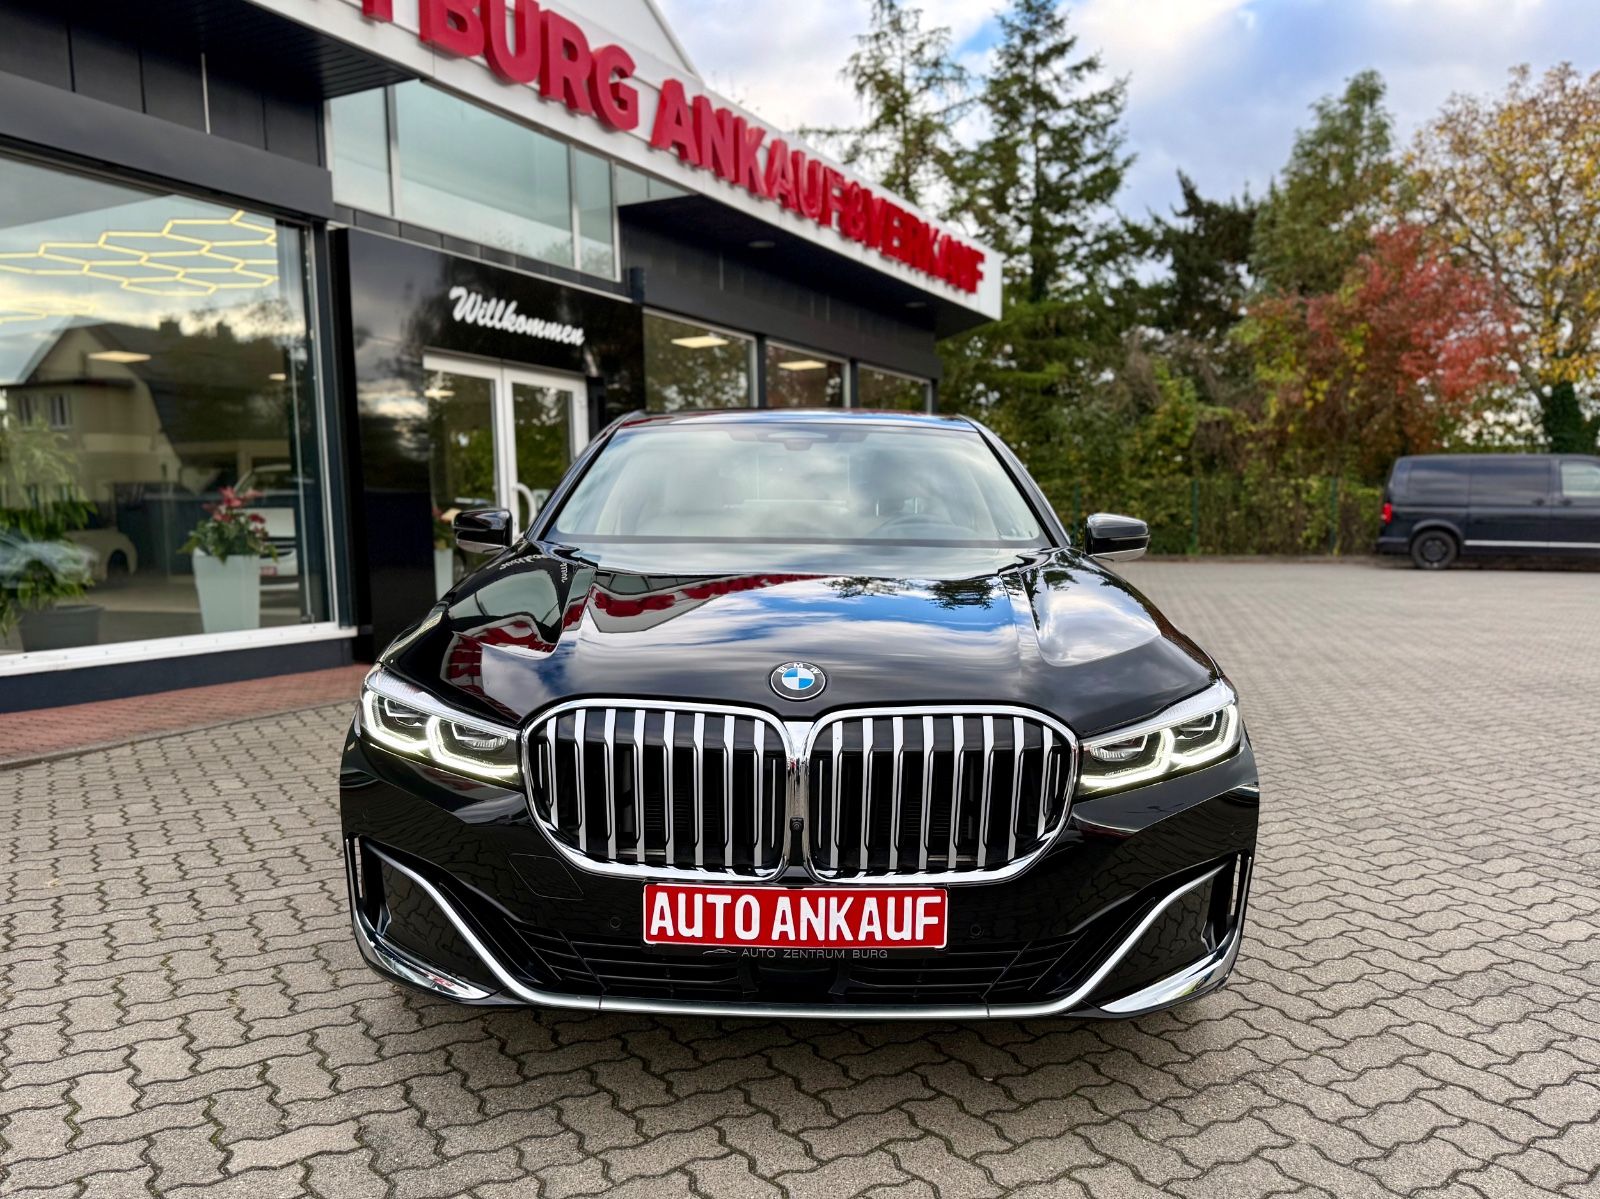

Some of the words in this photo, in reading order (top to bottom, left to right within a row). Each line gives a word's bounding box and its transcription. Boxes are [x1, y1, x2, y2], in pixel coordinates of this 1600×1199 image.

[419, 0, 639, 131] BURG
[449, 283, 585, 346] Willkommen
[776, 662, 821, 674] BMW
[650, 892, 760, 940] AUTO
[771, 896, 942, 941] ANKAUF
[741, 948, 776, 958] AUTO
[783, 949, 845, 959] ZENTRUM
[852, 949, 888, 959] BURG
